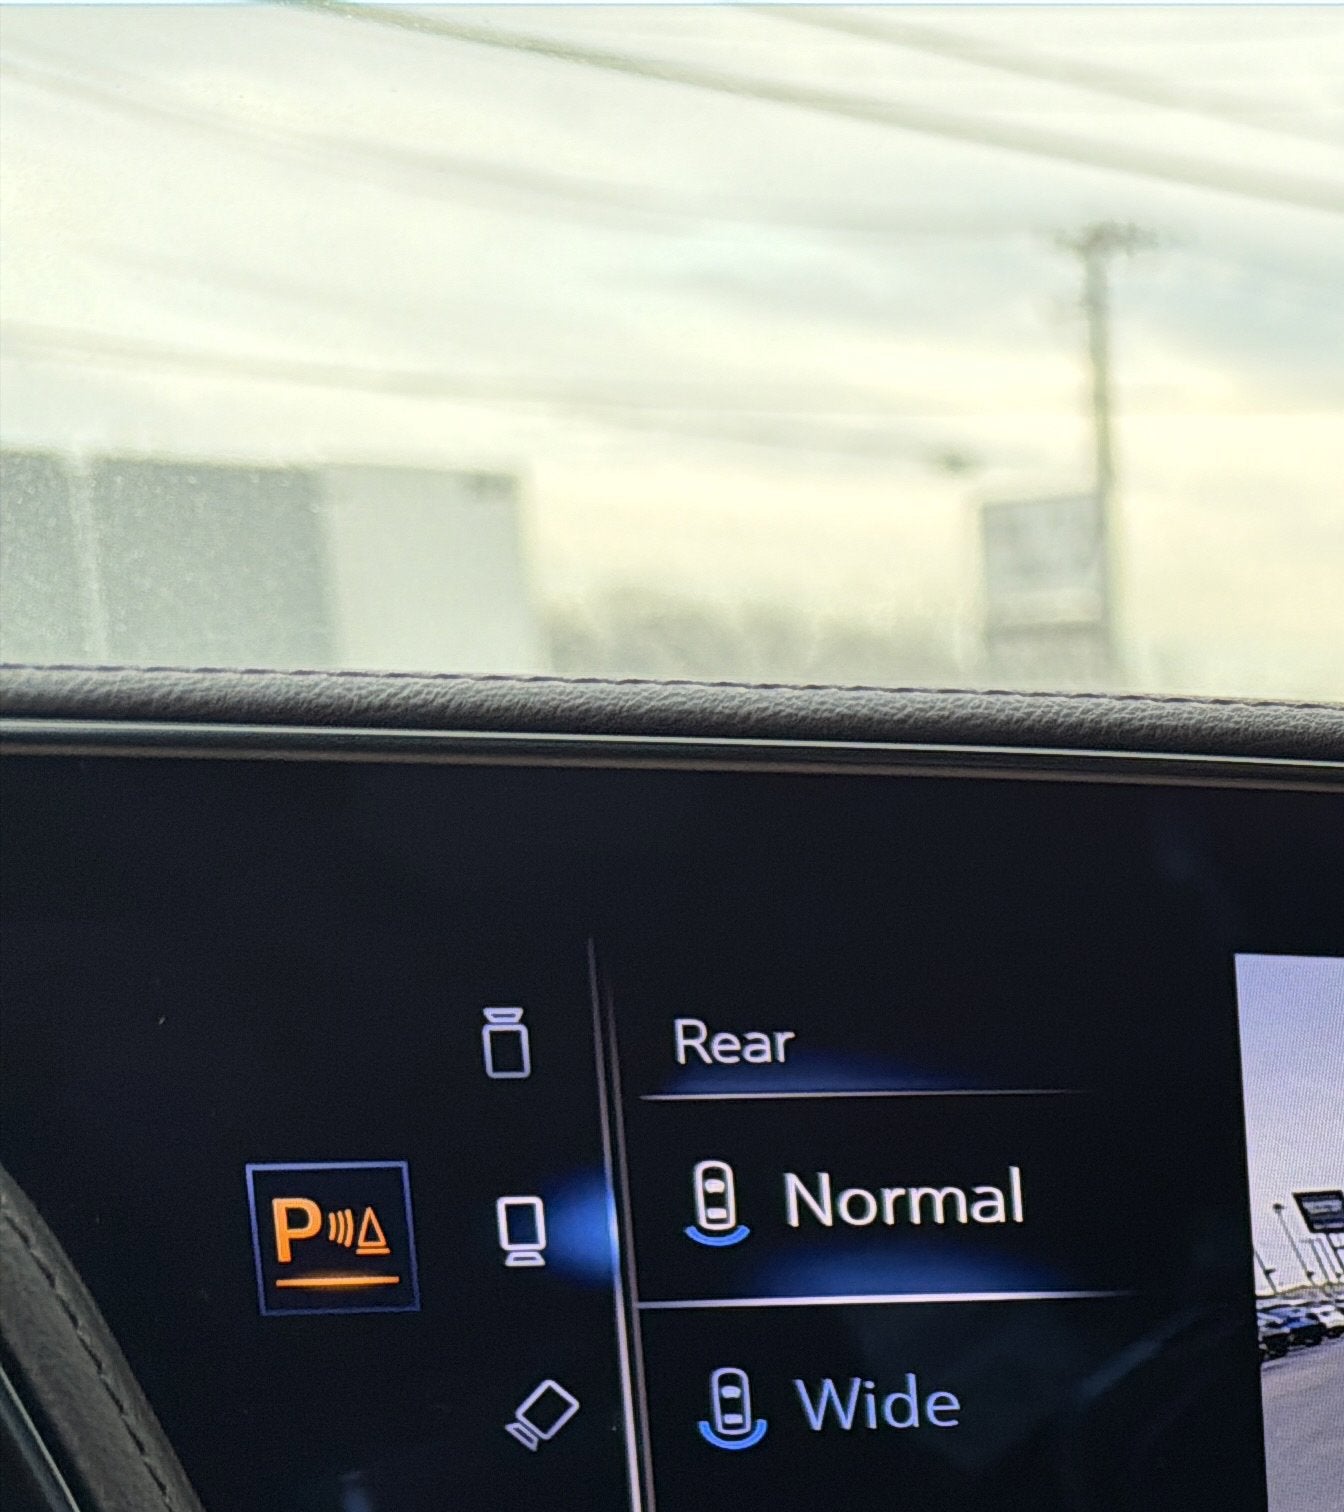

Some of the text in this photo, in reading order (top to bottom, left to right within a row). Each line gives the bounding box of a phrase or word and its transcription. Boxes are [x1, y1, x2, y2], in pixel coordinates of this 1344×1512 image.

[674, 1018, 795, 1065] Rear
[784, 1165, 1024, 1228] Normal
[795, 1372, 961, 1431] Wide
